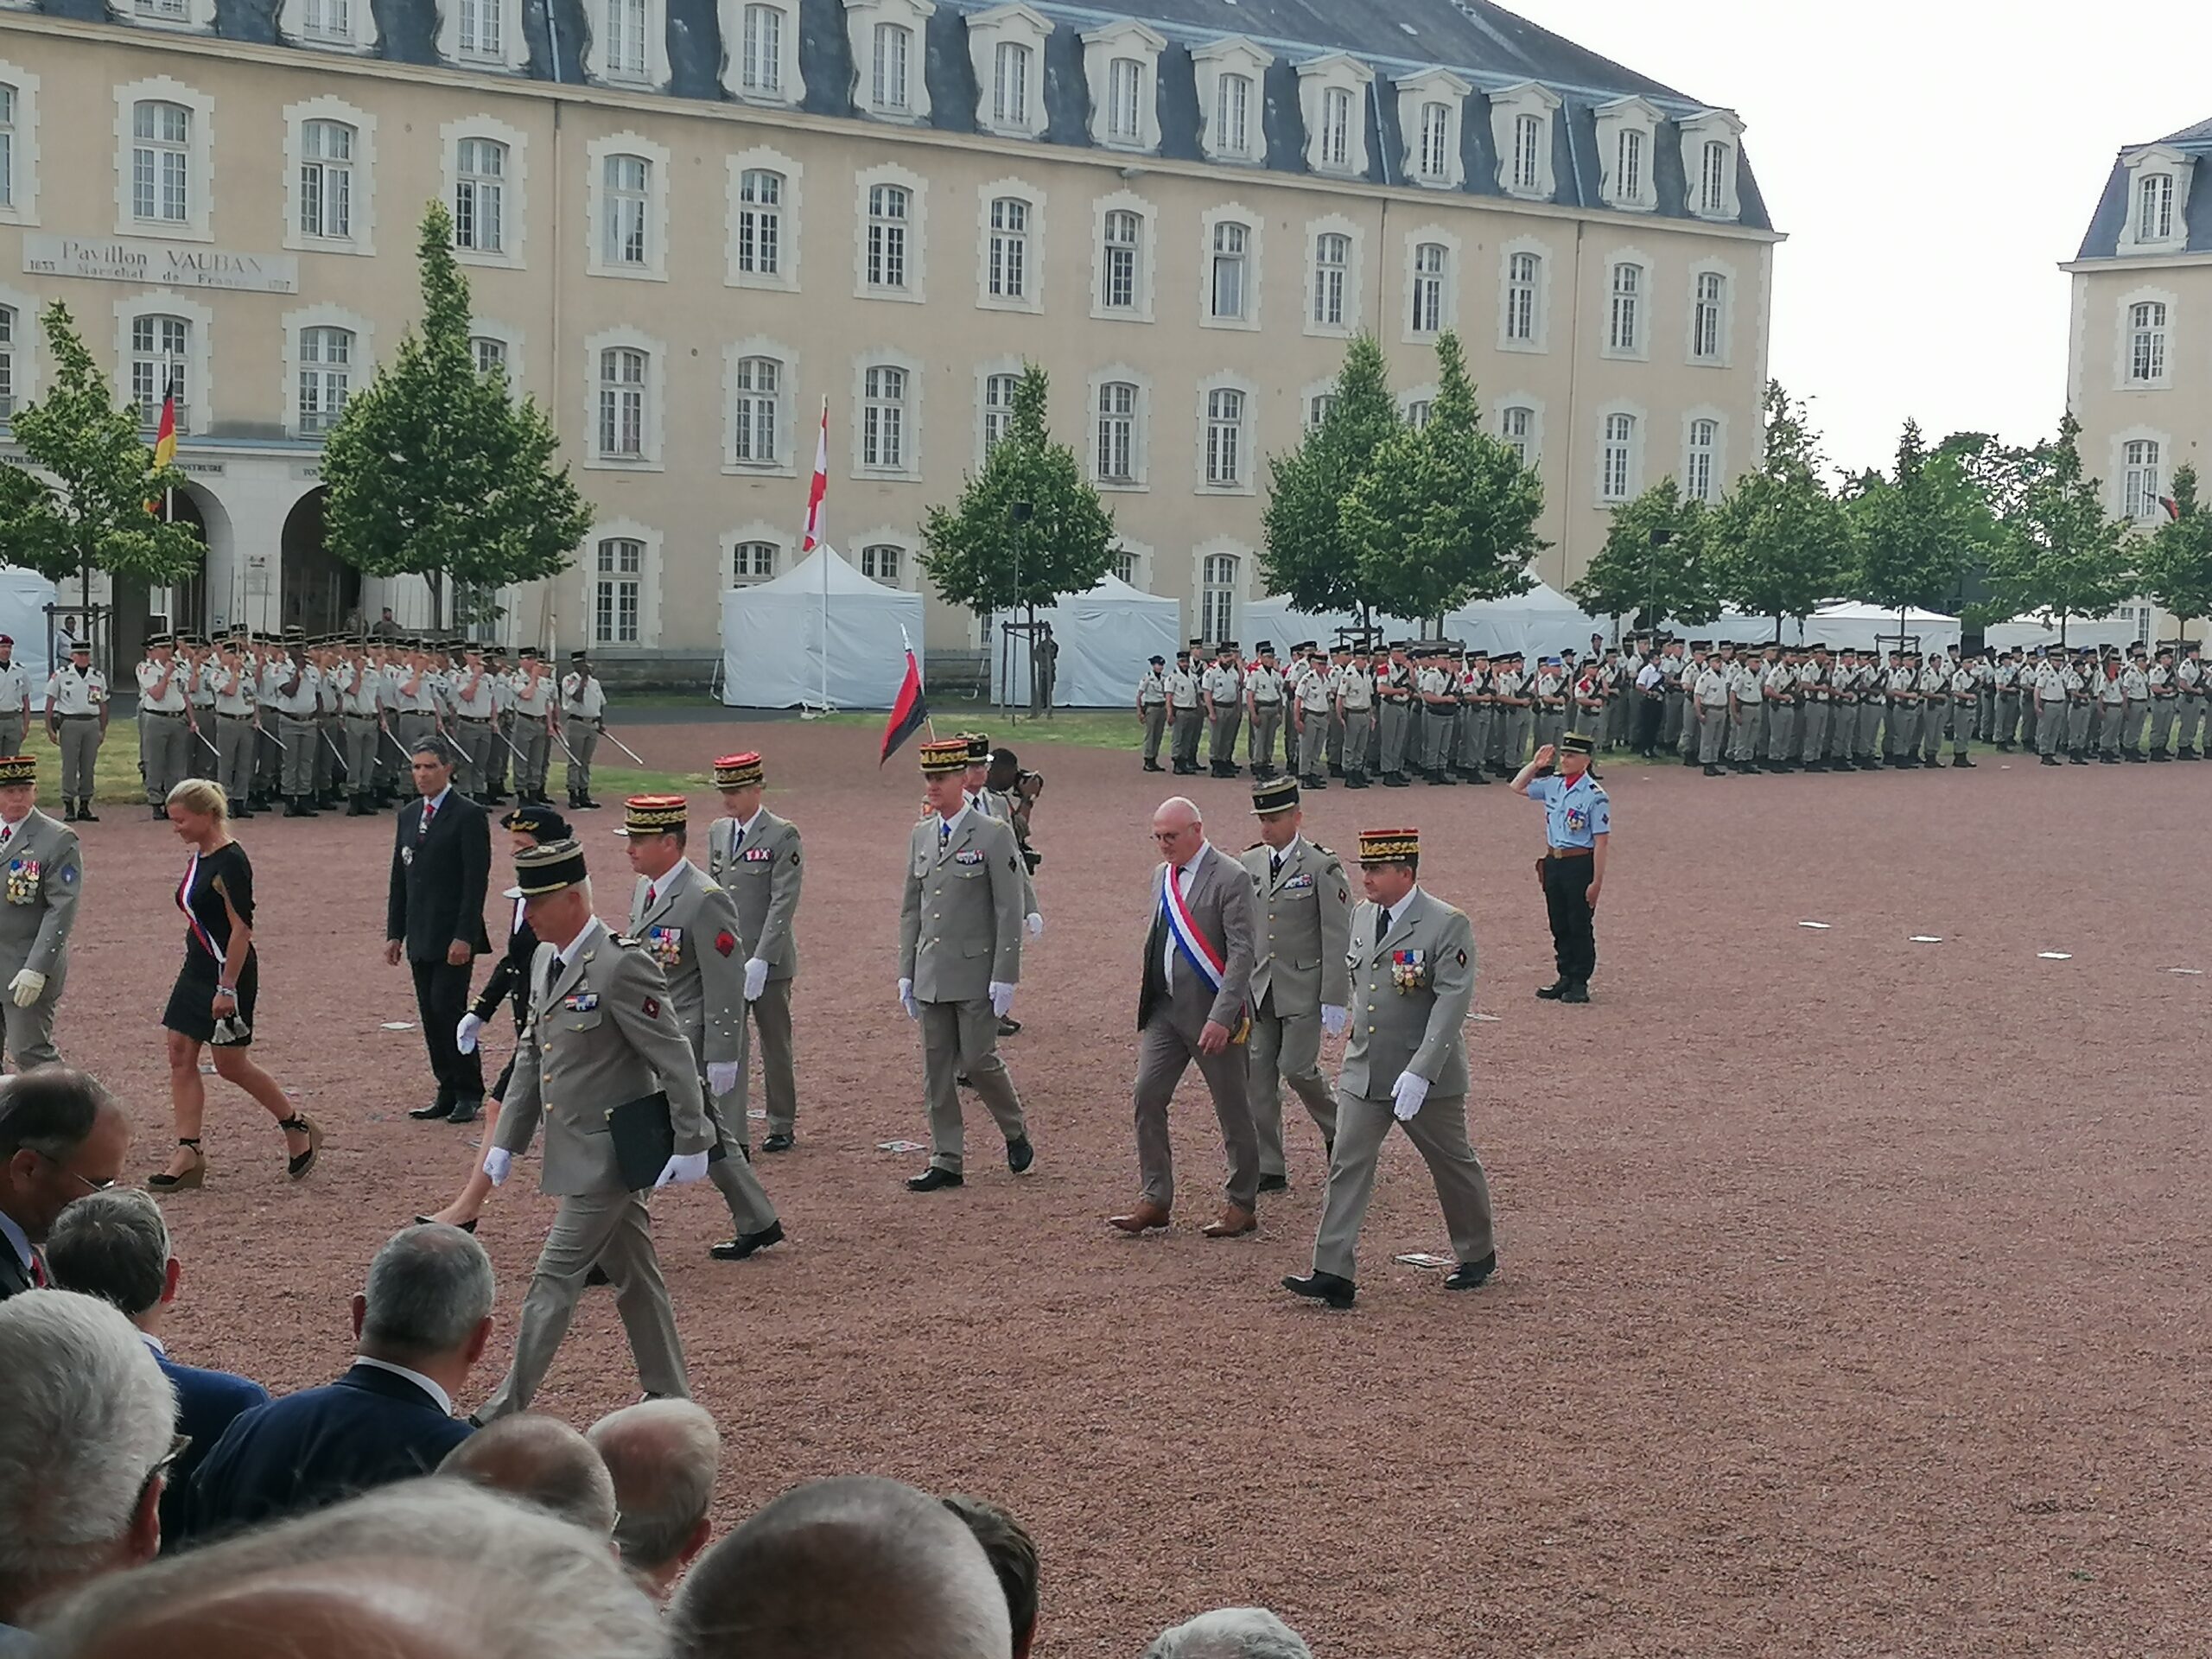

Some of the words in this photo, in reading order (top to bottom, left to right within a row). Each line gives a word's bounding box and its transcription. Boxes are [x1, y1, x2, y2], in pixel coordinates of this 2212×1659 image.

[62, 241, 148, 265] Pavillon
[167, 250, 263, 274] VAUBAN
[77, 263, 144, 279] Marchal
[162, 270, 180, 283] de
[197, 273, 249, 288] Franc
